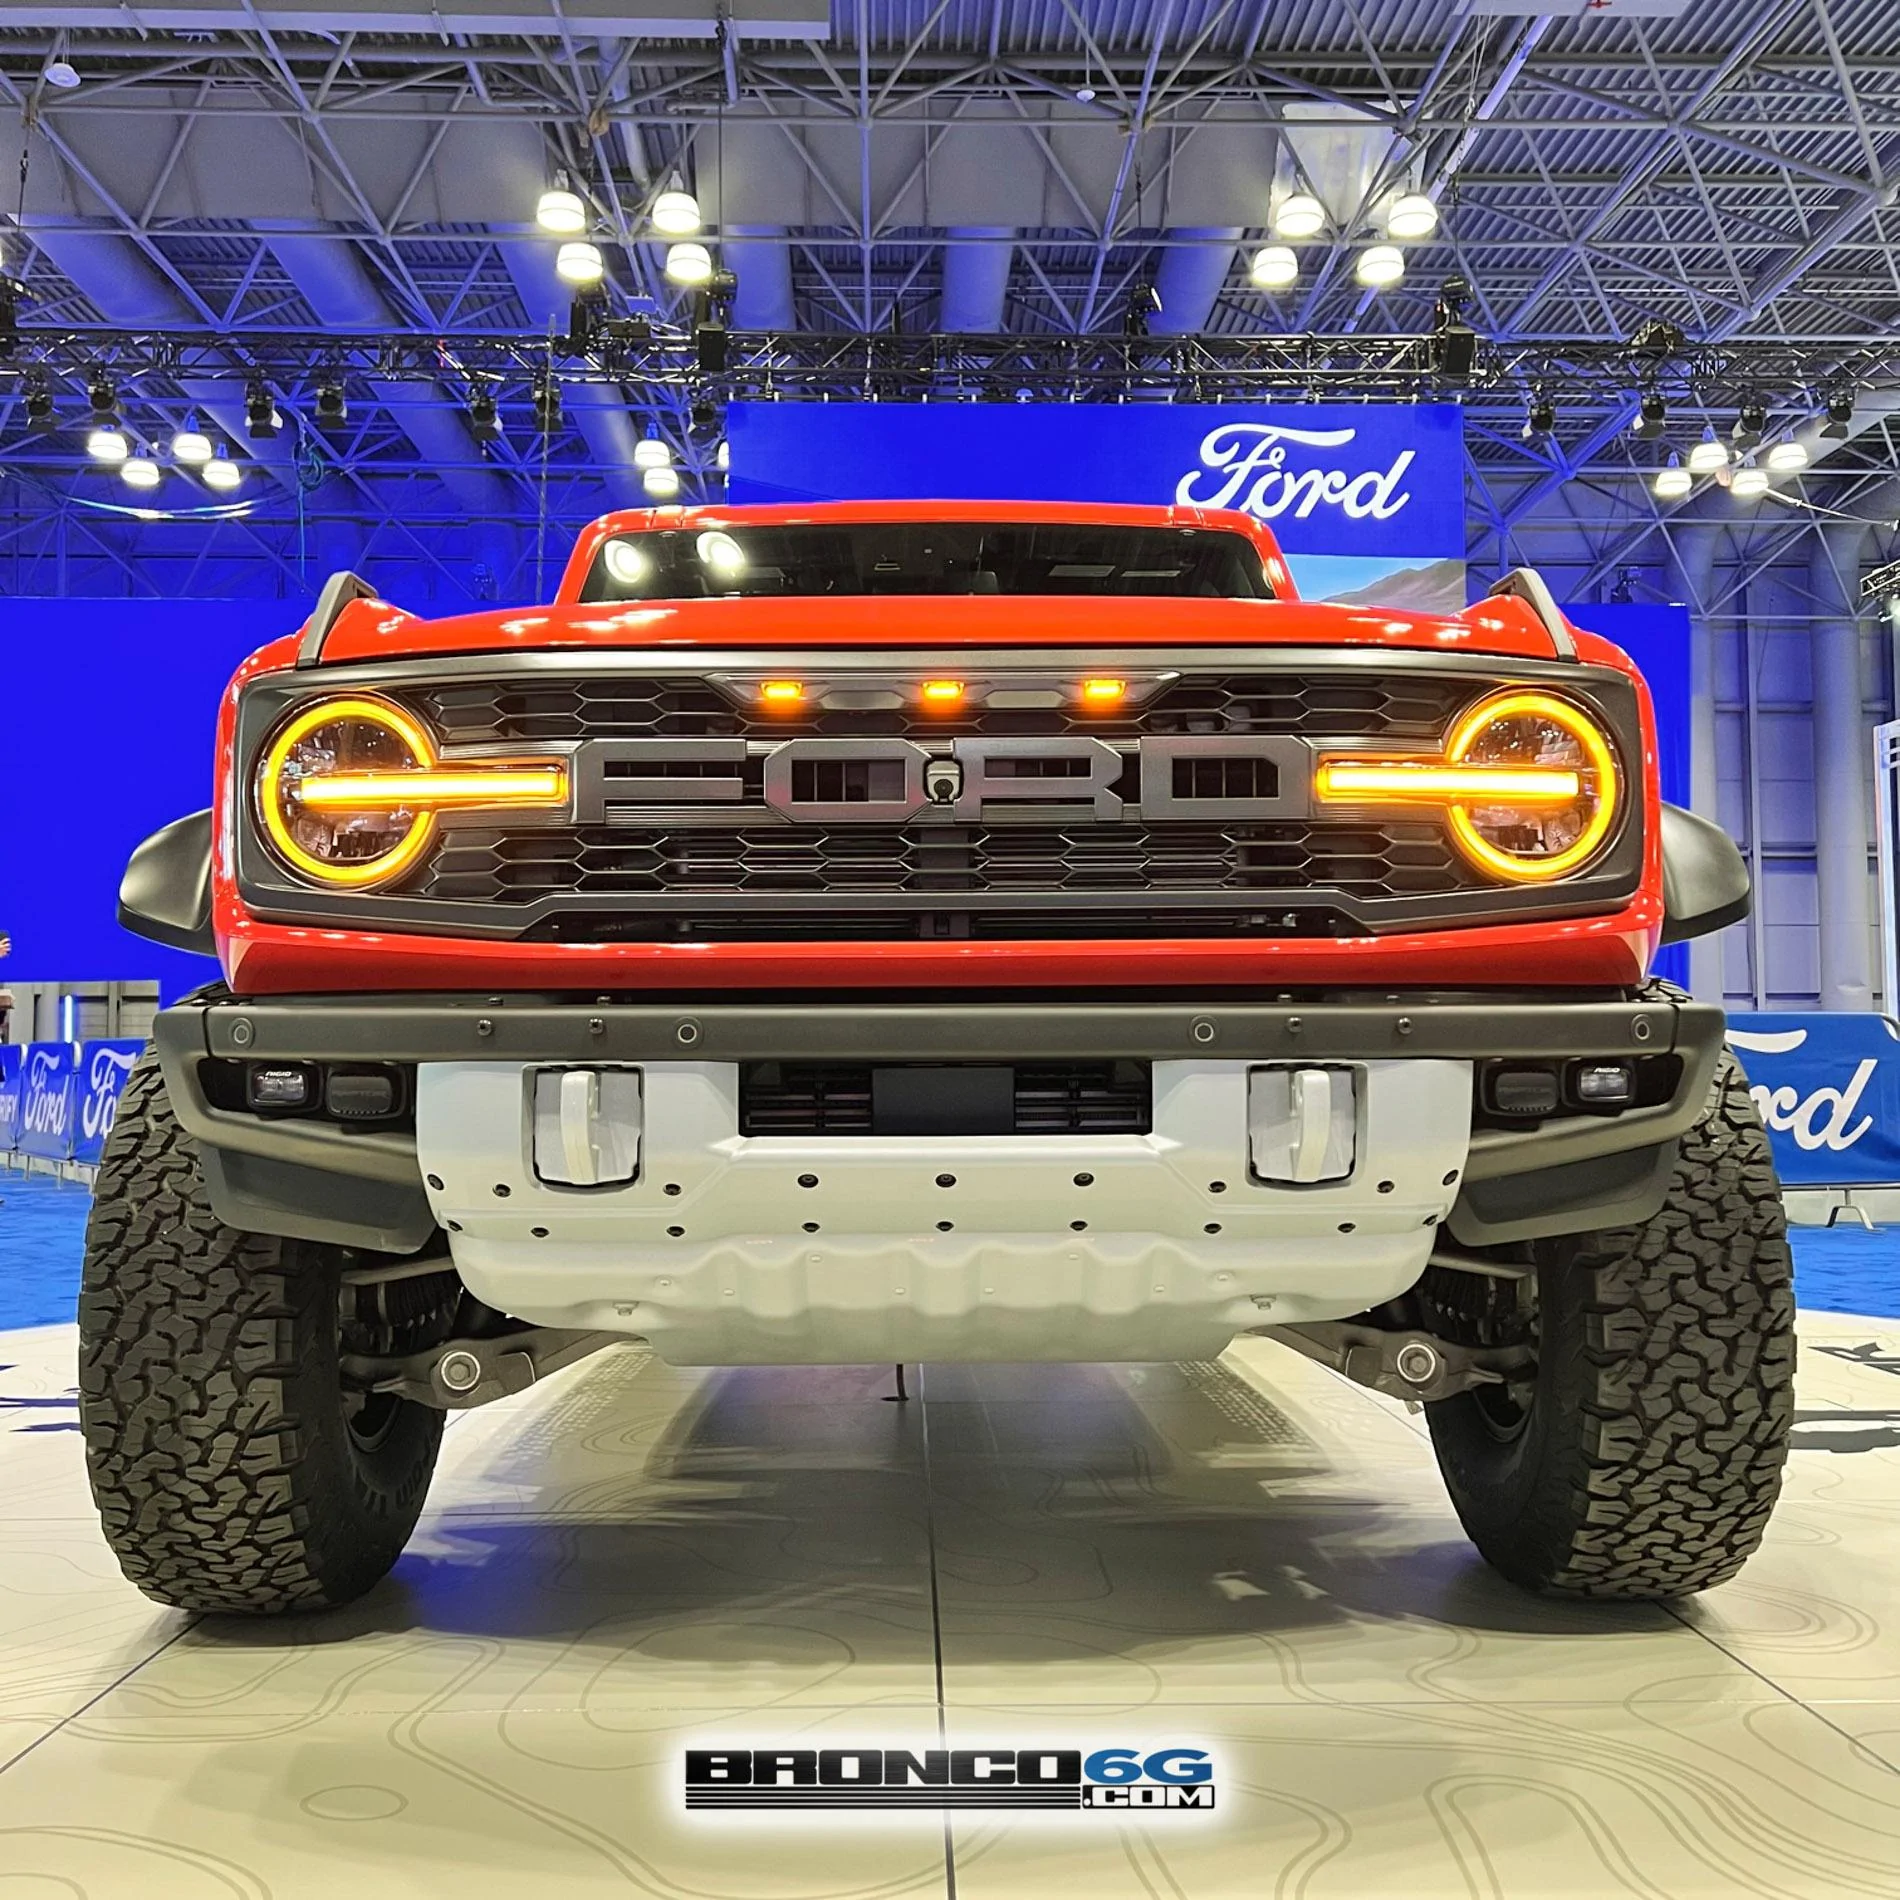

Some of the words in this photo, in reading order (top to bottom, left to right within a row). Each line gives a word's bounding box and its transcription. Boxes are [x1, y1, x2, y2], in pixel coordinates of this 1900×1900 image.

[1175, 422, 1416, 520] Ford
[572, 736, 1312, 823] FORD
[25, 1050, 70, 1137] Ford
[83, 1047, 137, 1140] Fo
[1724, 1029, 1878, 1151] rd
